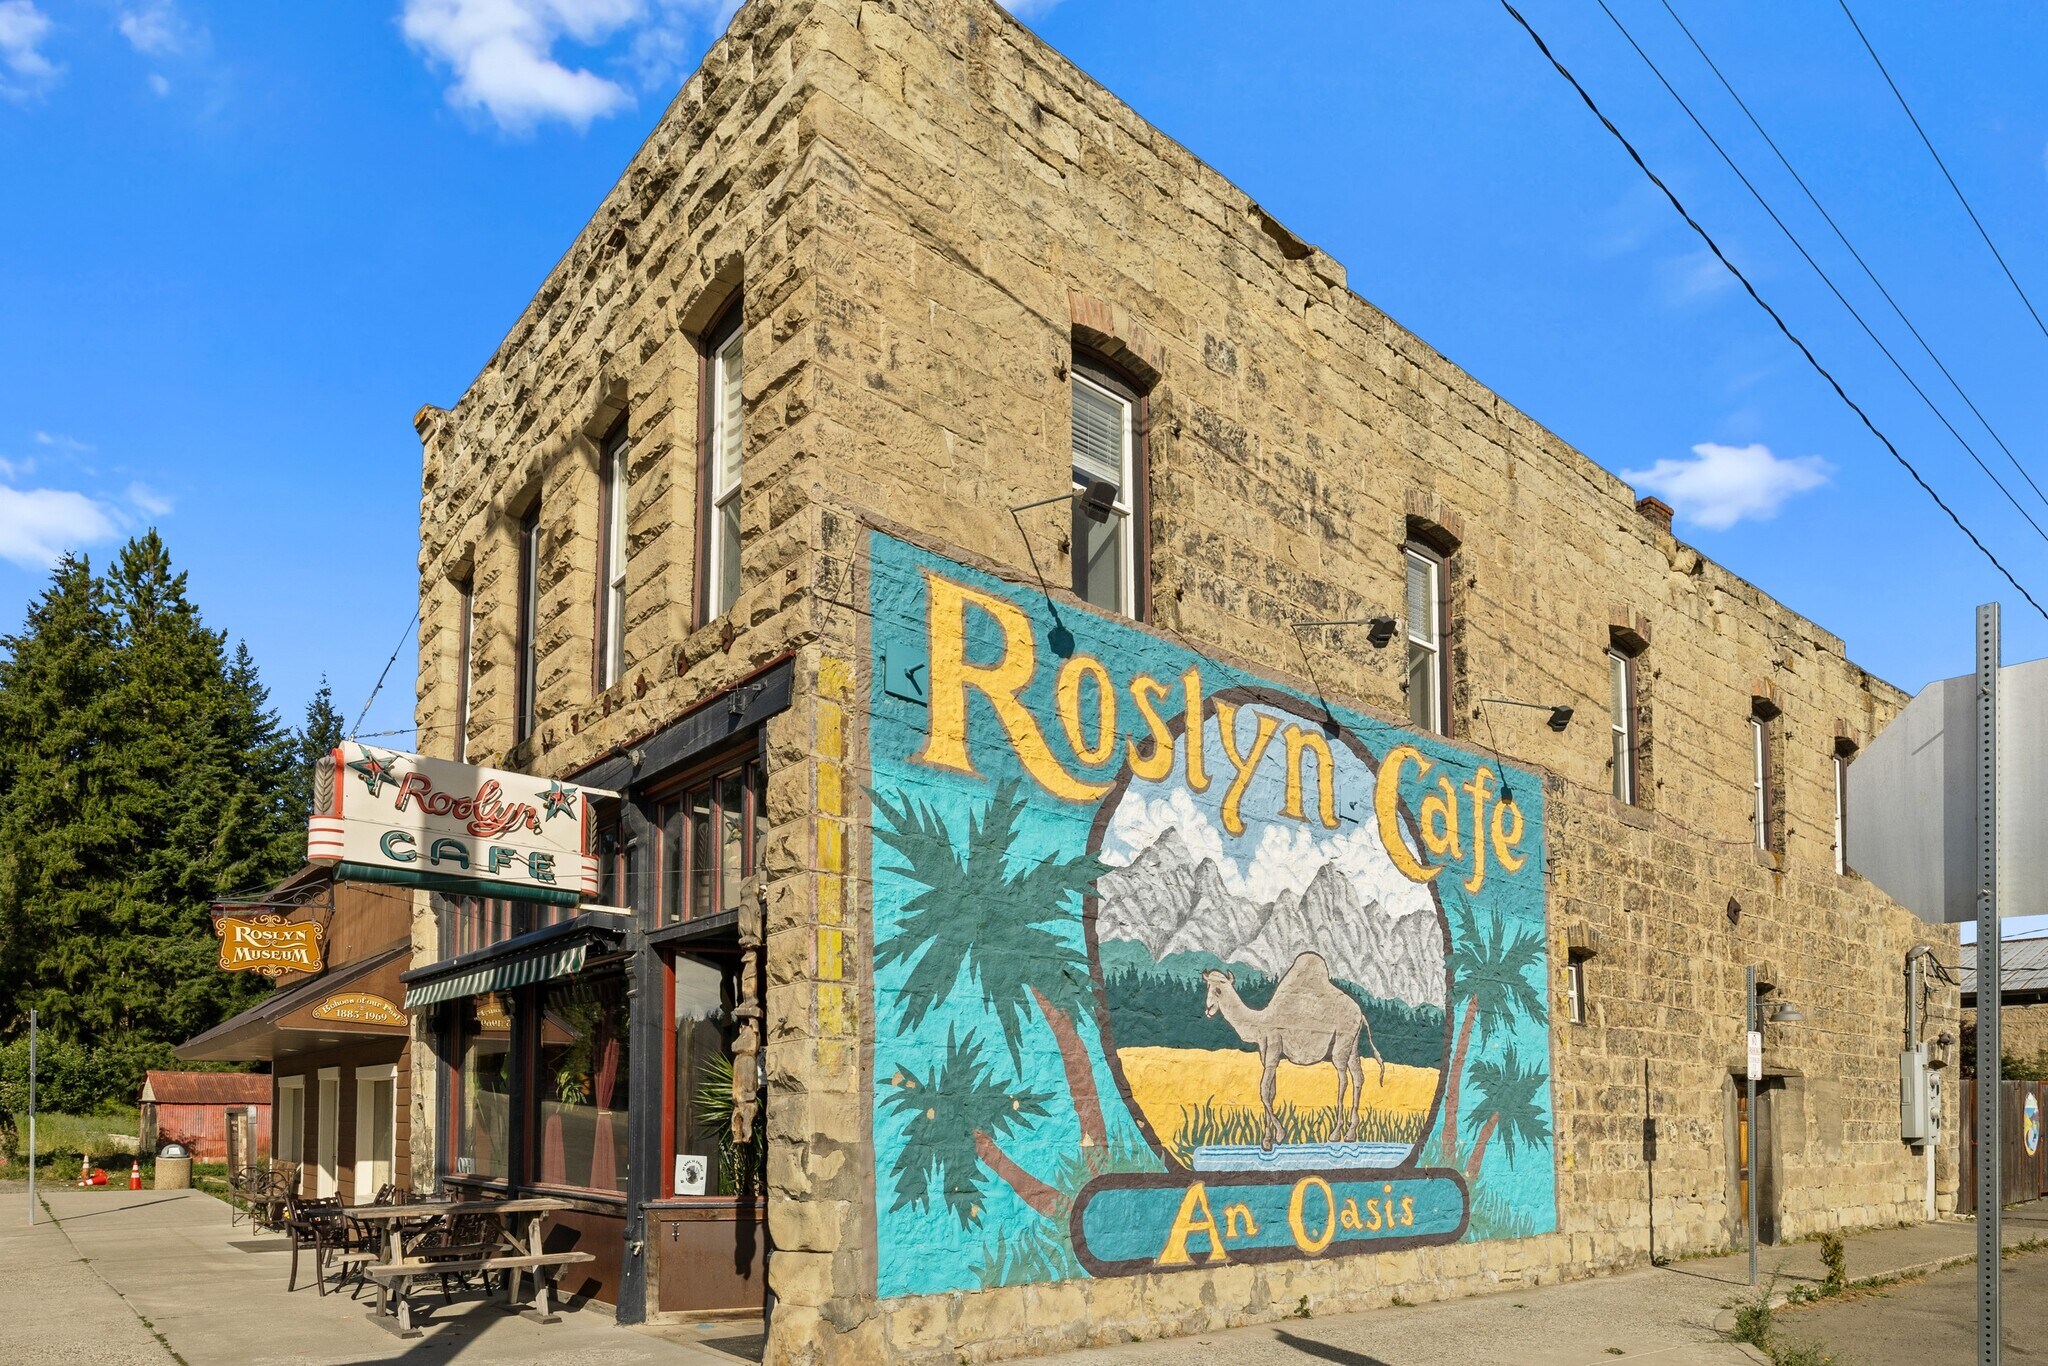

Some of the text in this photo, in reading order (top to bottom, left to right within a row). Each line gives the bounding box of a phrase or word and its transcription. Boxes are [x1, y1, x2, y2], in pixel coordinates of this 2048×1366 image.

[914, 571, 1527, 895] Roslyn Cafe
[395, 772, 543, 837] Roslyn
[380, 830, 556, 884] CAFE
[232, 947, 311, 965] MUSEUM
[233, 925, 308, 946] ROSLYN
[322, 998, 355, 1014] Echoes
[383, 1003, 401, 1021] Past
[1155, 1176, 1414, 1266] An Oasis
